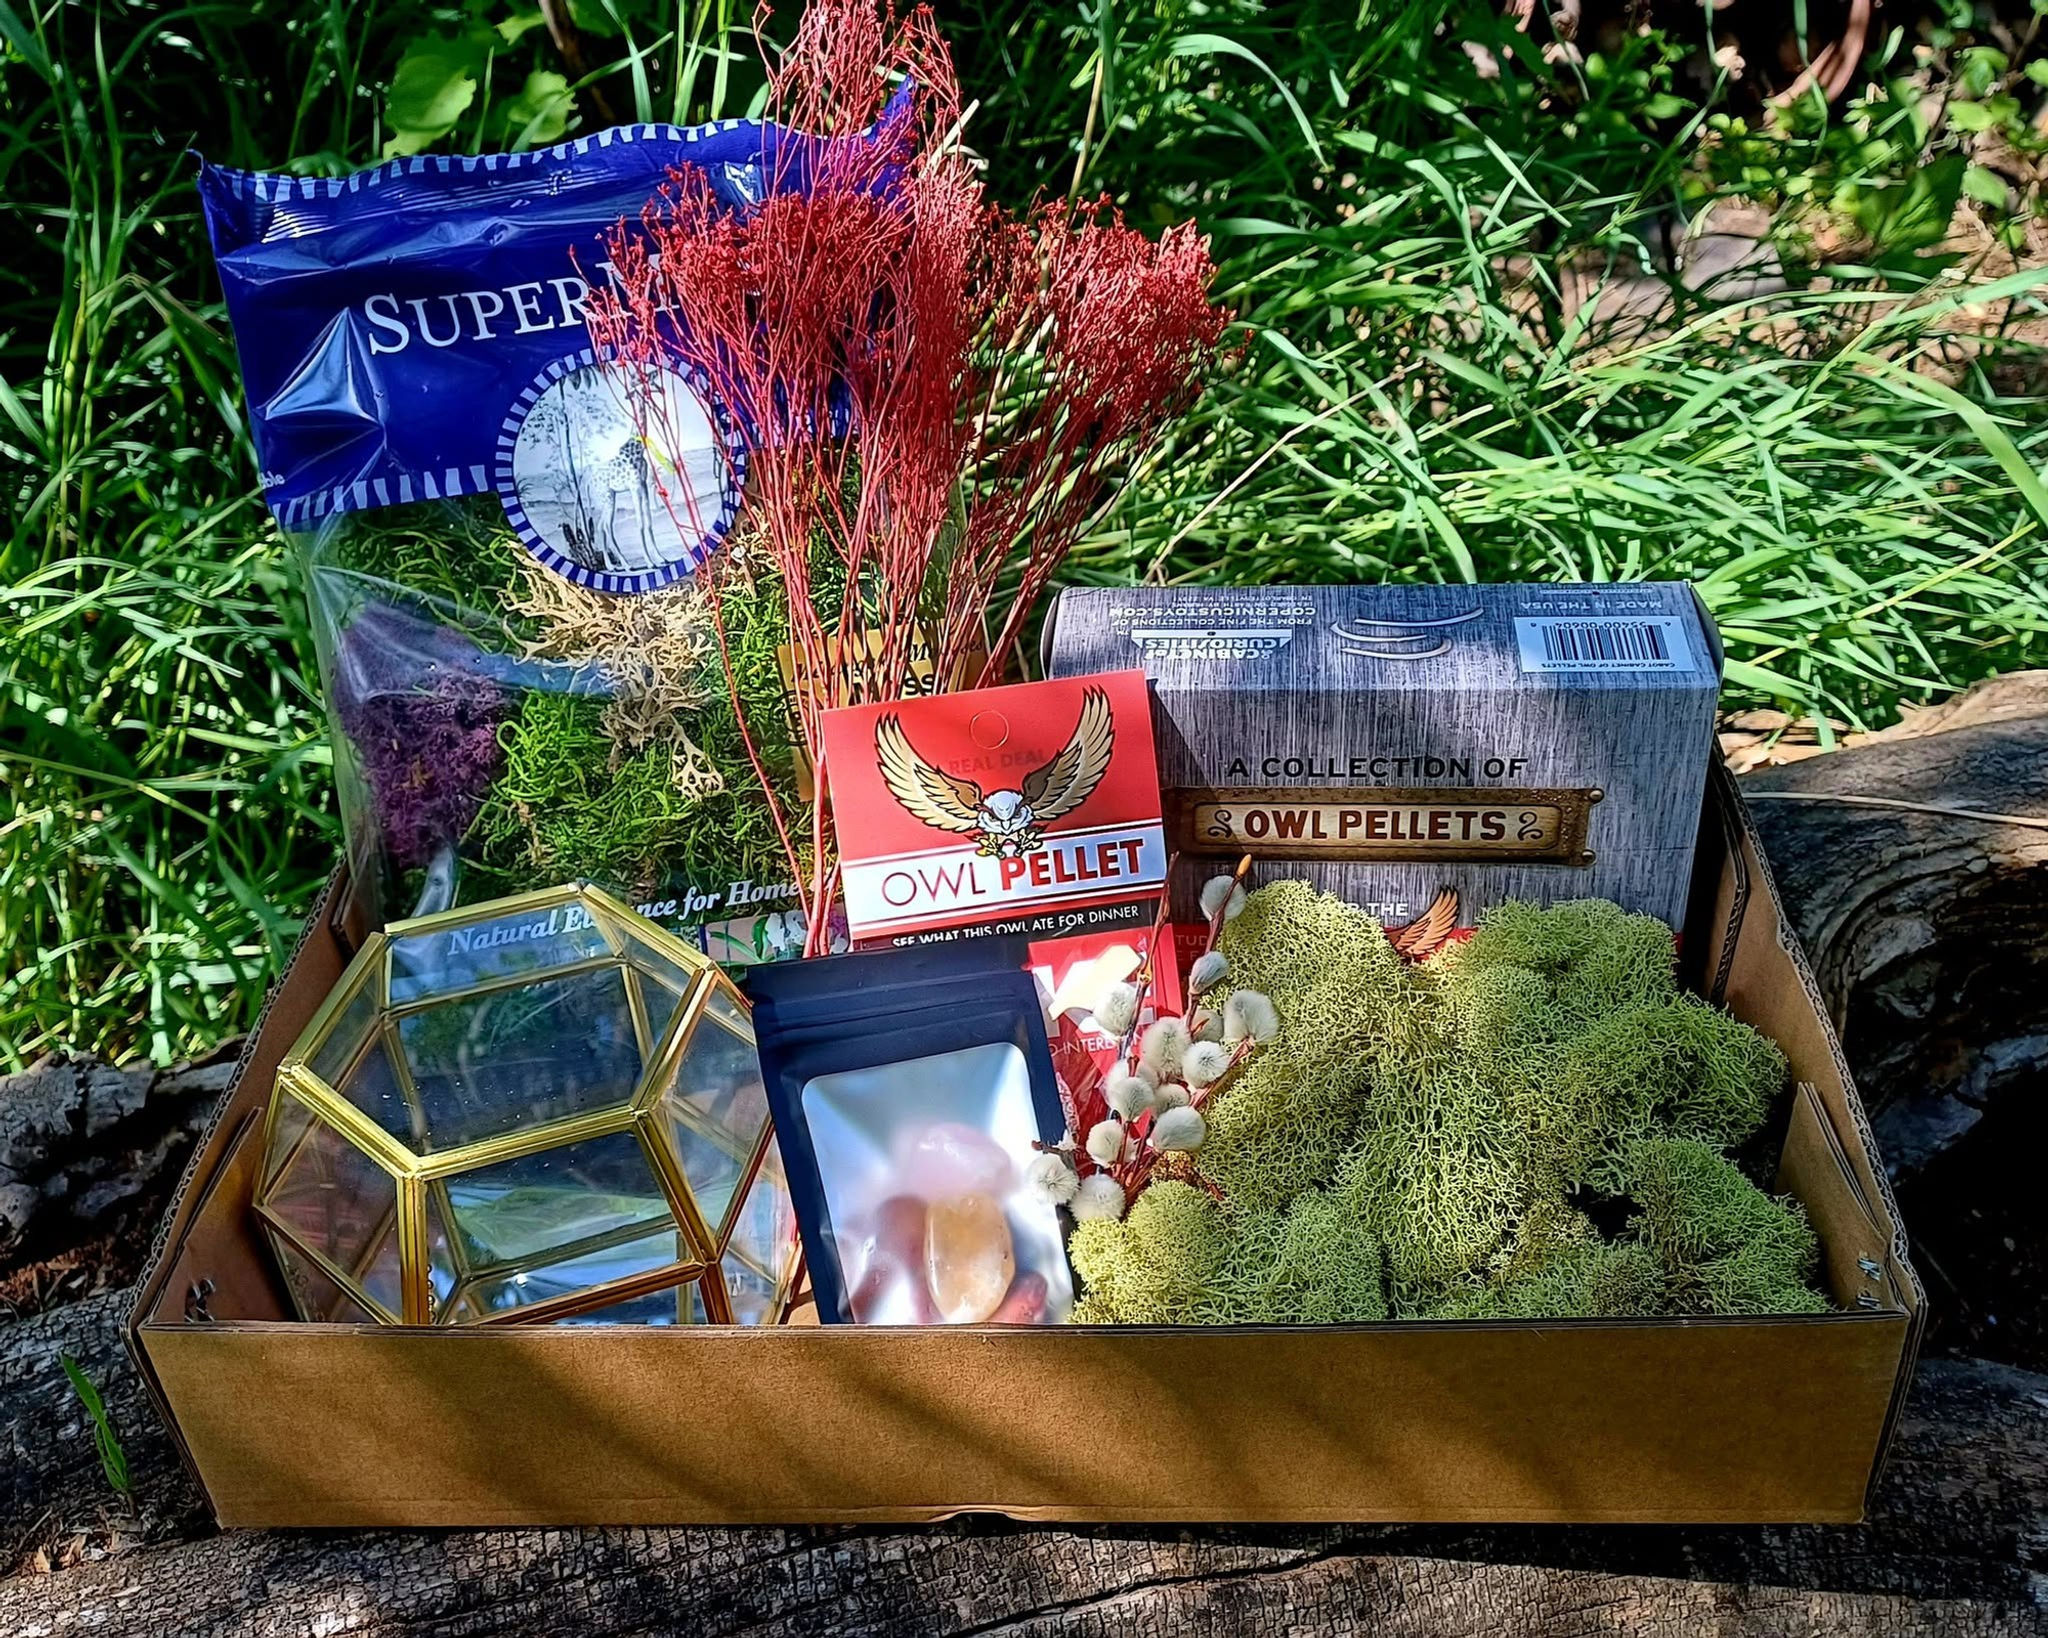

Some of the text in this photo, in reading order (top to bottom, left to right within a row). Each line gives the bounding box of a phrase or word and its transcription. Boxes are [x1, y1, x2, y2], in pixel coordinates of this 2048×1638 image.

[1109, 607, 1316, 617] COPERNICUSTOYS.COM
[1520, 600, 1662, 610] MADE IN THE USA
[1112, 617, 1312, 626] FROM THE FINE COLLECTIONS OF
[1145, 638, 1277, 649] CURIOSITIES
[949, 749, 1049, 775] REAL DEAL
[1228, 757, 1528, 779] A COLLECTION OF
[1244, 809, 1507, 841] OWL PELLETS
[882, 838, 1145, 906] OWL PELLET
[446, 909, 558, 956] Natural
[678, 886, 721, 921] for
[725, 879, 800, 907] Home
[1367, 902, 1409, 917] THE
[919, 930, 960, 945] WHAT
[962, 925, 993, 939] THIS
[996, 920, 1029, 935] OWL
[1032, 916, 1056, 932] ATE
[1058, 913, 1086, 929] FOR
[1089, 905, 1139, 924] DINNER
